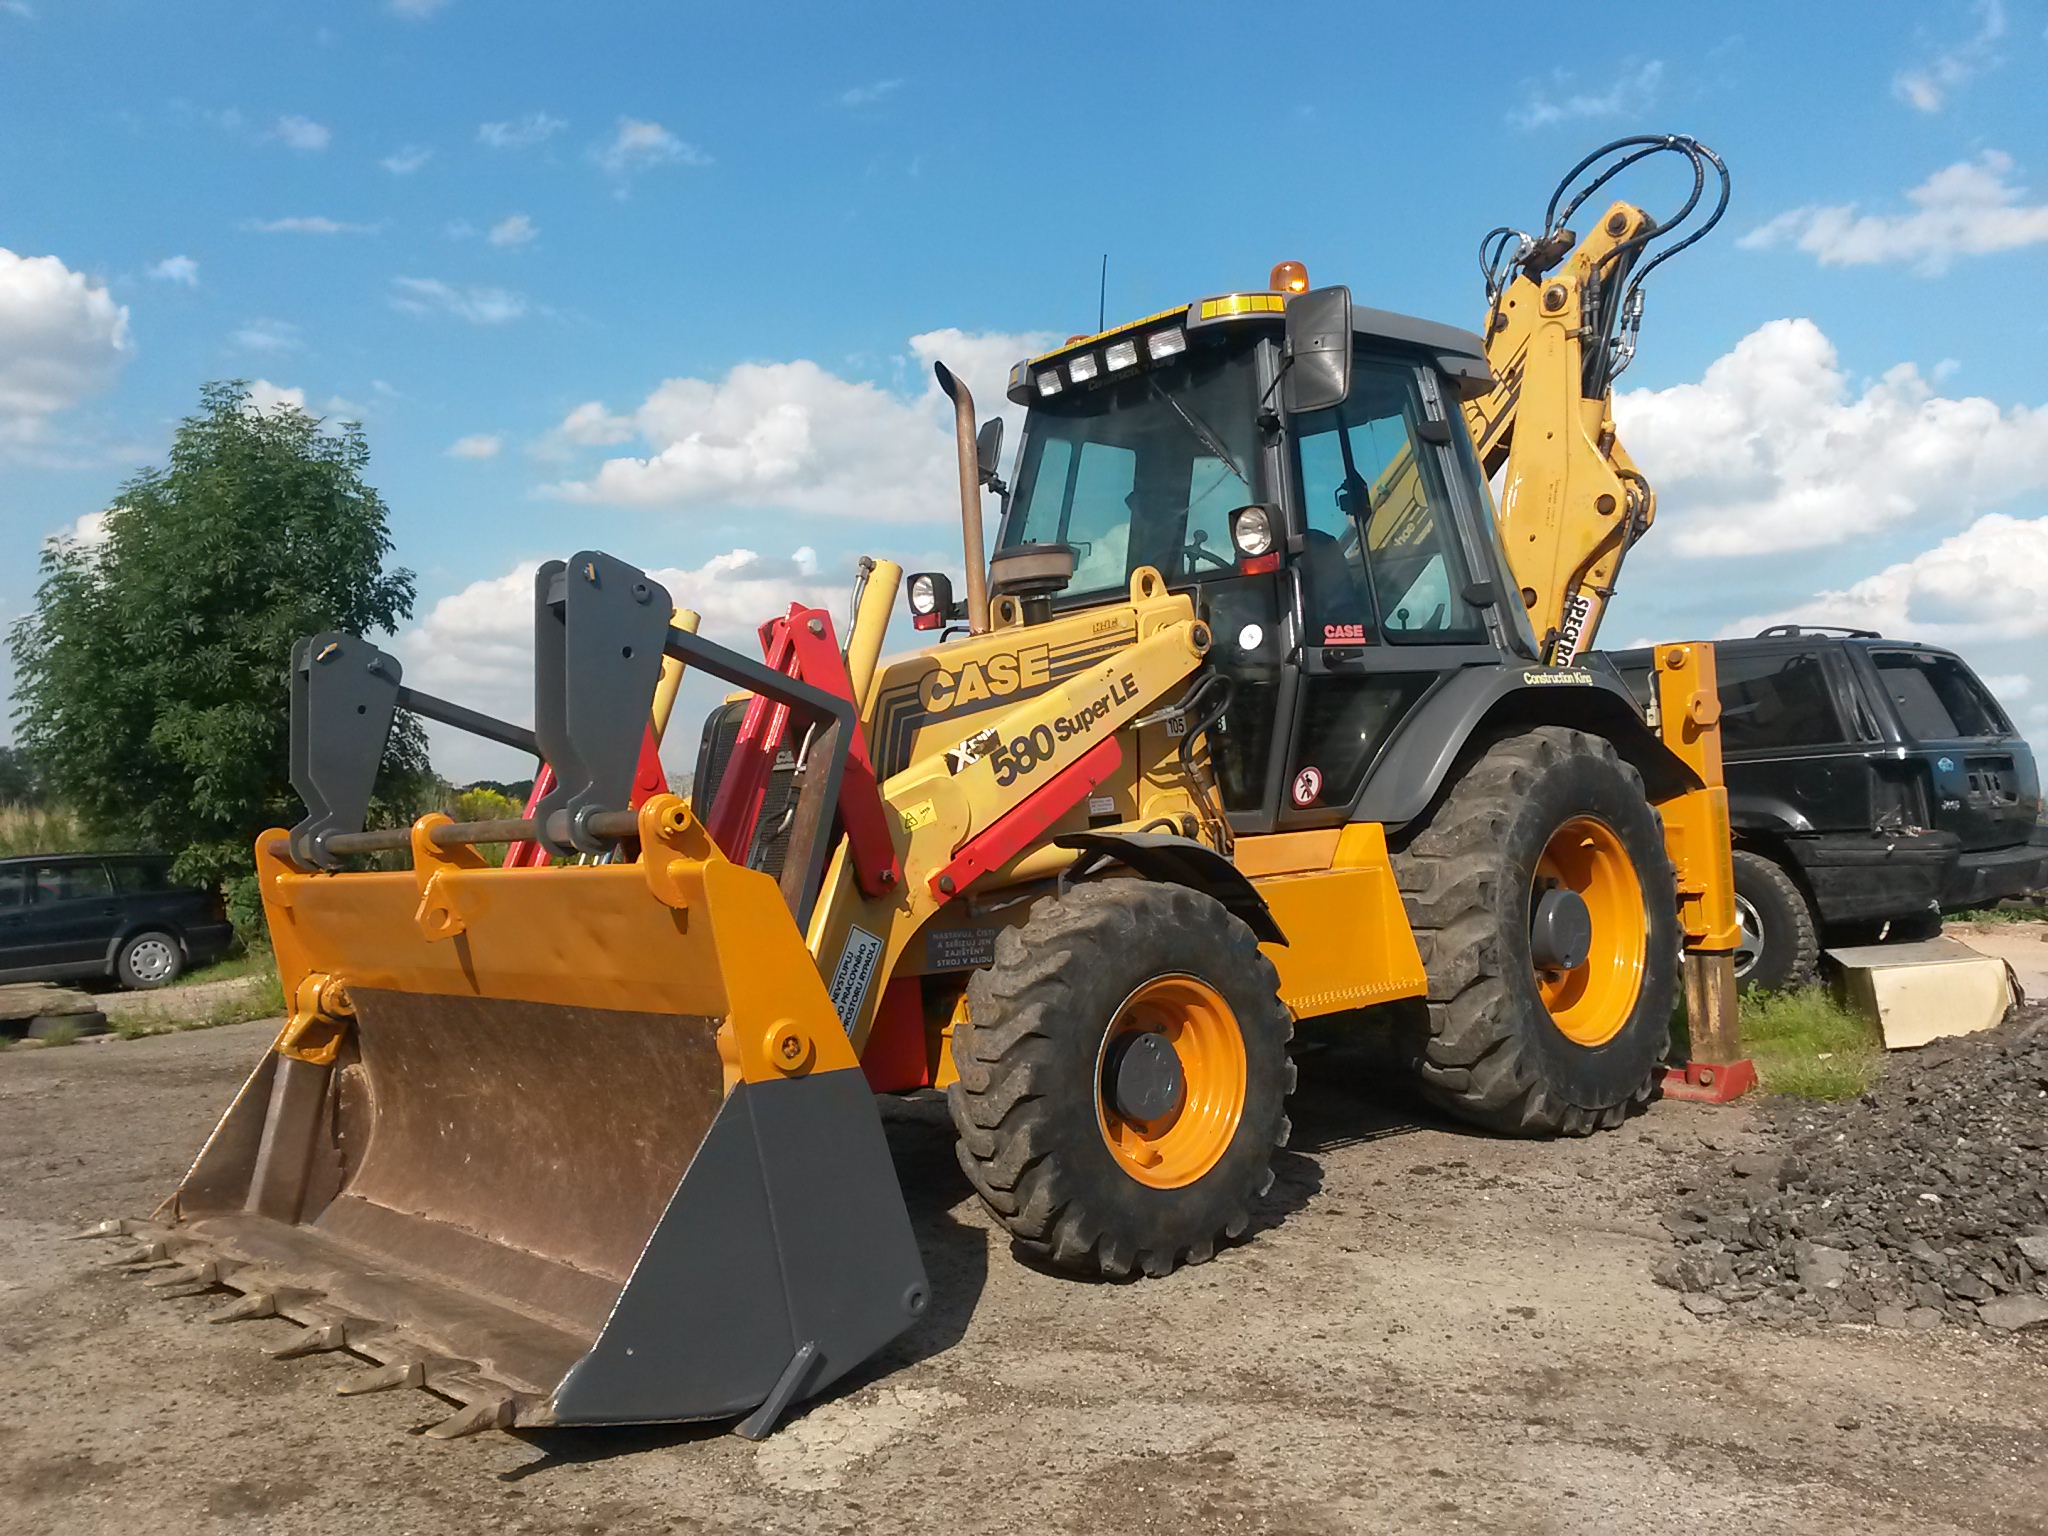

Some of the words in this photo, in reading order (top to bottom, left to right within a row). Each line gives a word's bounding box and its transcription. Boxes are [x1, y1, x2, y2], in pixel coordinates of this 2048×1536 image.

[1323, 624, 1364, 638] CASE
[918, 643, 1051, 713] CASE
[1523, 672, 1573, 685] Construction
[1573, 672, 1594, 687] King
[989, 724, 1055, 787] 580
[1054, 695, 1112, 742] Super
[1109, 672, 1140, 707] LE
[1169, 718, 1185, 733] 105
[976, 927, 995, 938] ČISTI
[831, 951, 854, 1004] NEVSTUPUJ
[841, 943, 867, 1005] PRACOVNÍHO
[937, 957, 961, 967] STROJ
[970, 955, 993, 964] KLIDU
[842, 982, 863, 1032] PROSTORU
[859, 942, 878, 982] RYPADLA
